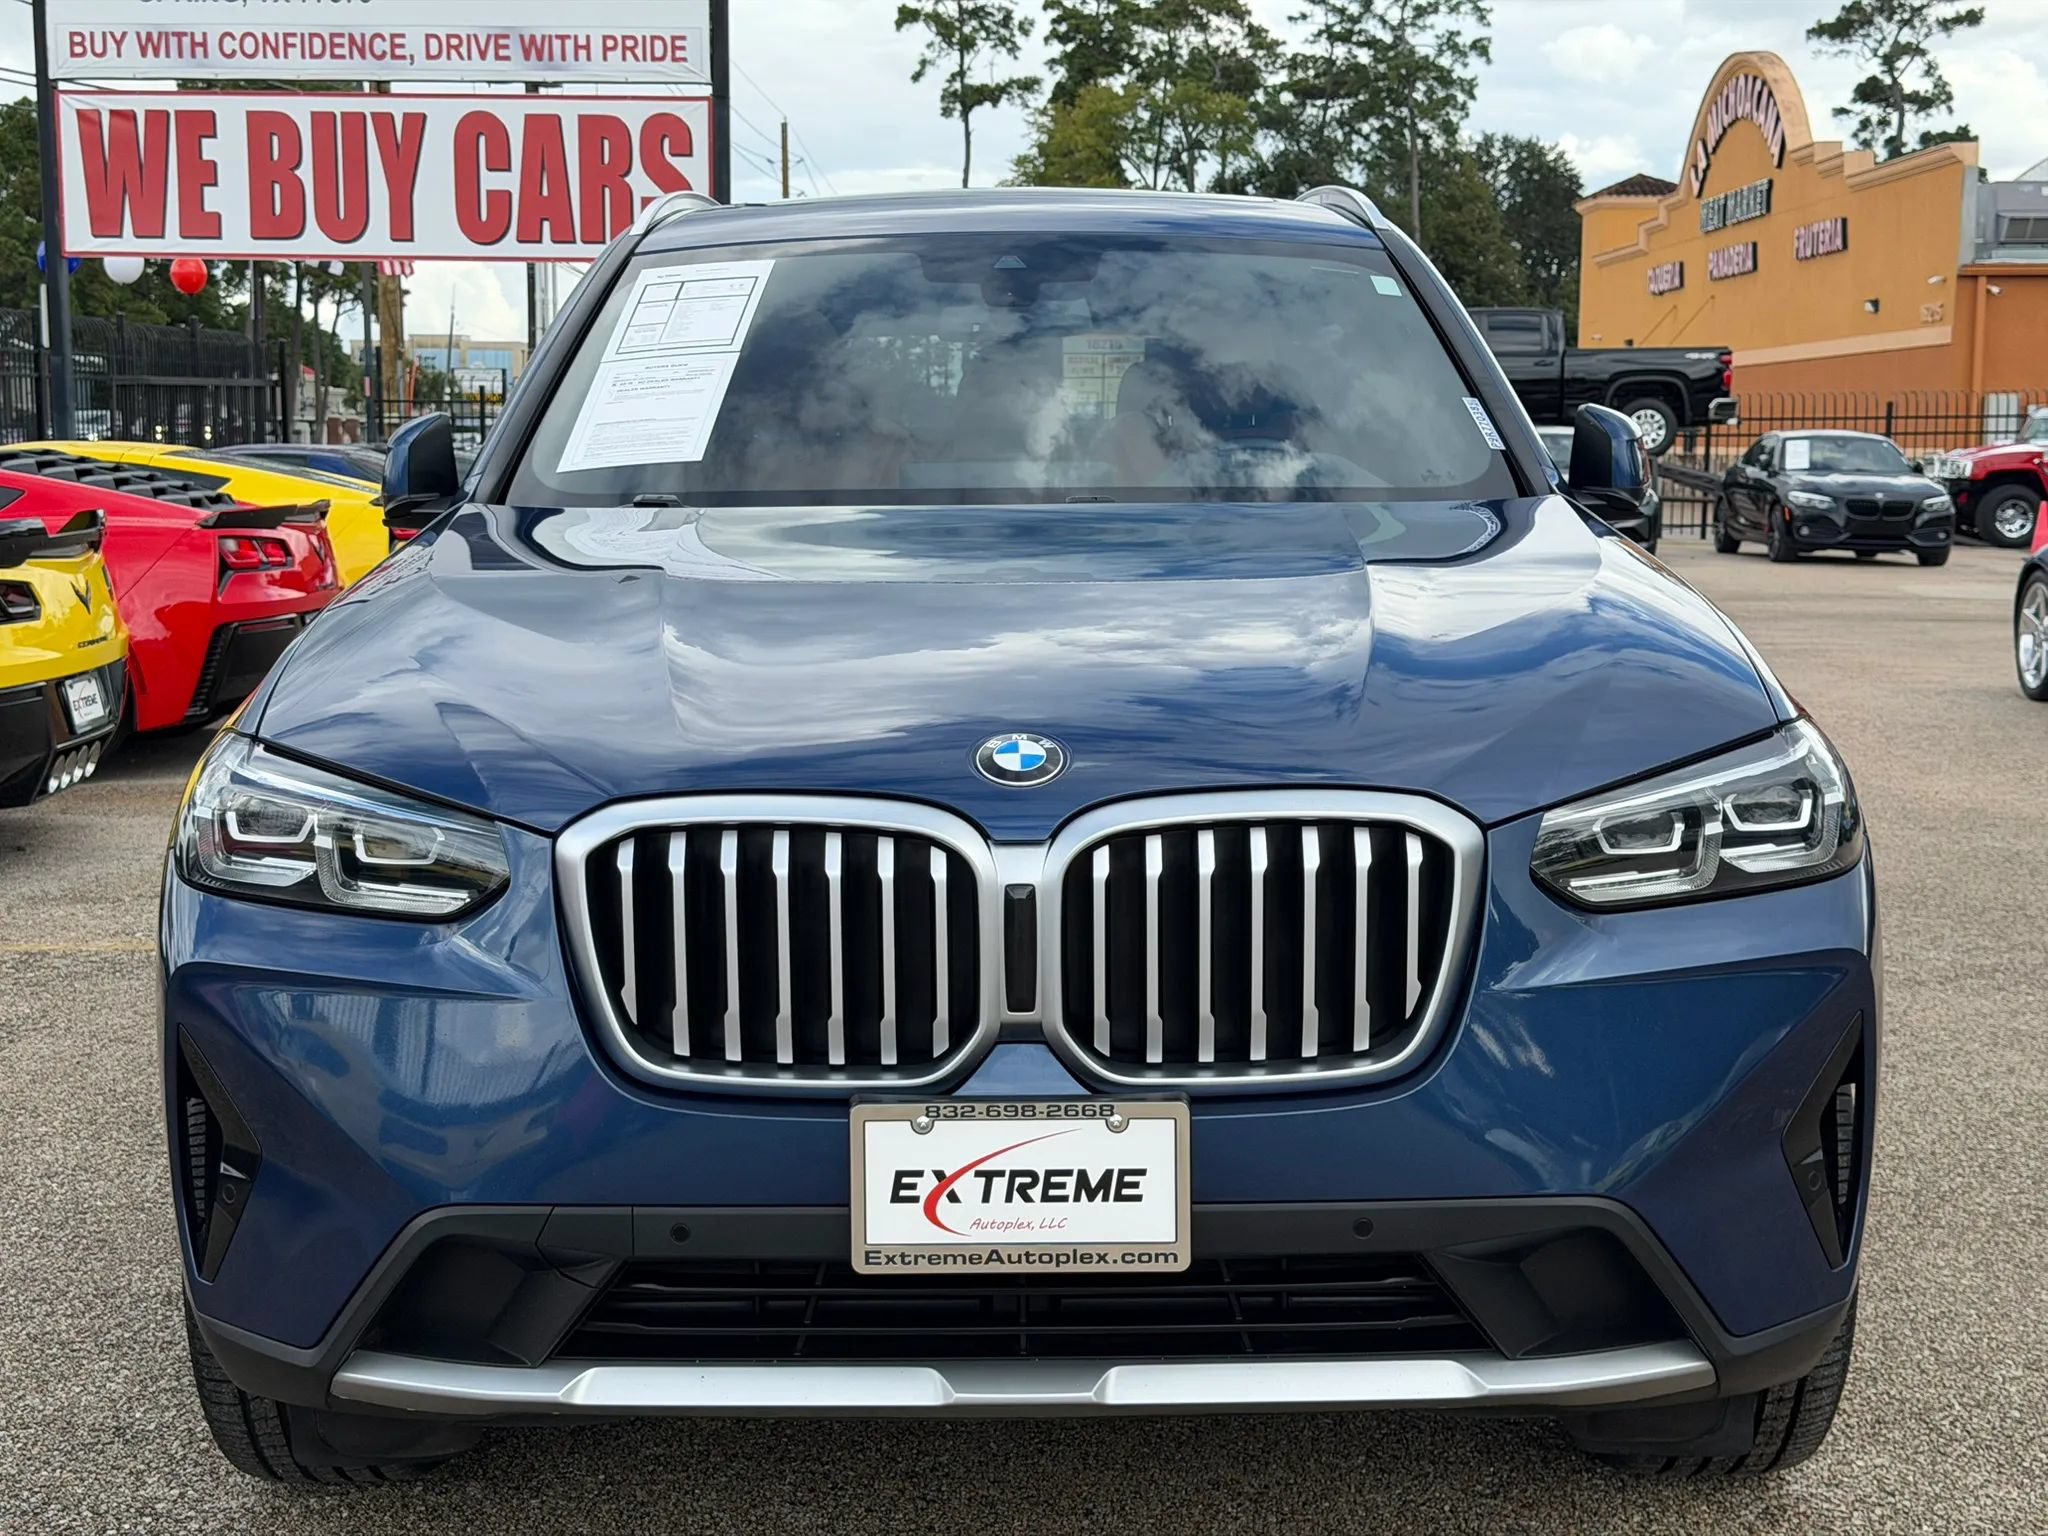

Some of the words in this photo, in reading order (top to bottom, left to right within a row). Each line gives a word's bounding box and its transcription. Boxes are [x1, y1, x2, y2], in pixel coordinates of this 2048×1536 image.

[68, 31, 127, 60] BUY
[138, 31, 208, 60] WITH
[217, 31, 415, 65] CONFIDENCE,
[425, 33, 511, 62] DRIVE
[518, 34, 587, 63] WITH
[602, 35, 688, 64] PRIDE
[1707, 73, 1785, 169] MICHOACANA
[76, 108, 222, 240] WE
[247, 110, 427, 244] BUY
[453, 111, 693, 245] CARS
[1726, 178, 1771, 226] MARKET
[1794, 217, 1845, 259] FRUTERIA
[1708, 241, 1756, 281] PANADERIA
[925, 1104, 1115, 1118] 832-698-2668
[889, 1167, 1148, 1204] EXTREME
[969, 1217, 1034, 1233] Autoplex,
[1039, 1217, 1068, 1230] LLC
[864, 1248, 1179, 1267] ExtremeAutoplex.com
